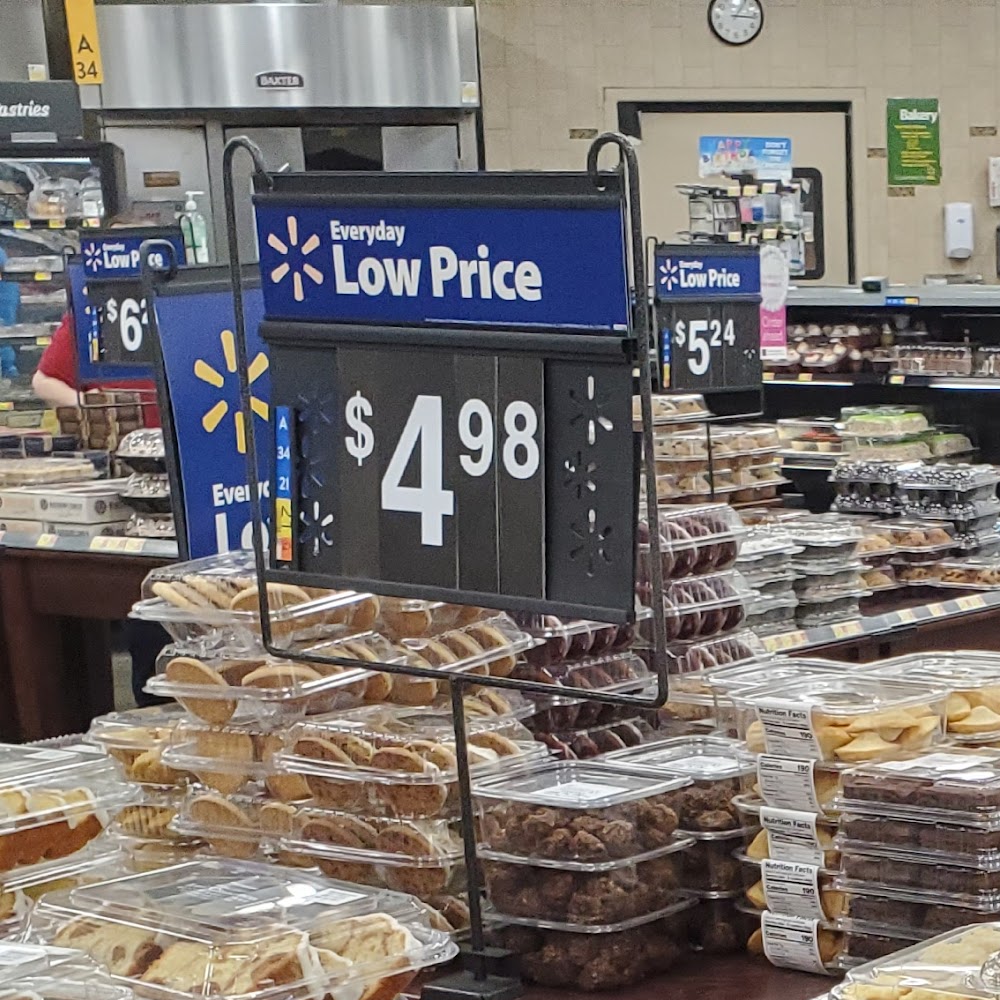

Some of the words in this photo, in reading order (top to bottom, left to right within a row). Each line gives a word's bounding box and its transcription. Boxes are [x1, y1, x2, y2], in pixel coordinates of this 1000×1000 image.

[78, 35, 93, 53] A
[76, 61, 98, 79] 34
[0, 101, 50, 117] astries
[900, 108, 937, 124] Bakery
[330, 219, 405, 247] Everyday
[131, 251, 163, 267] Pce
[332, 244, 421, 297] Low
[430, 244, 542, 301] Price
[680, 269, 707, 288] Low
[708, 268, 741, 287] Price
[279, 417, 287, 430] A
[277, 446, 290, 459] 34
[278, 476, 289, 490] 21
[764, 817, 791, 826] Nutrition
[793, 820, 811, 829] Facts
[766, 863, 793, 871] Nutrition
[794, 866, 813, 874] Facts
[802, 887, 815, 895] 190
